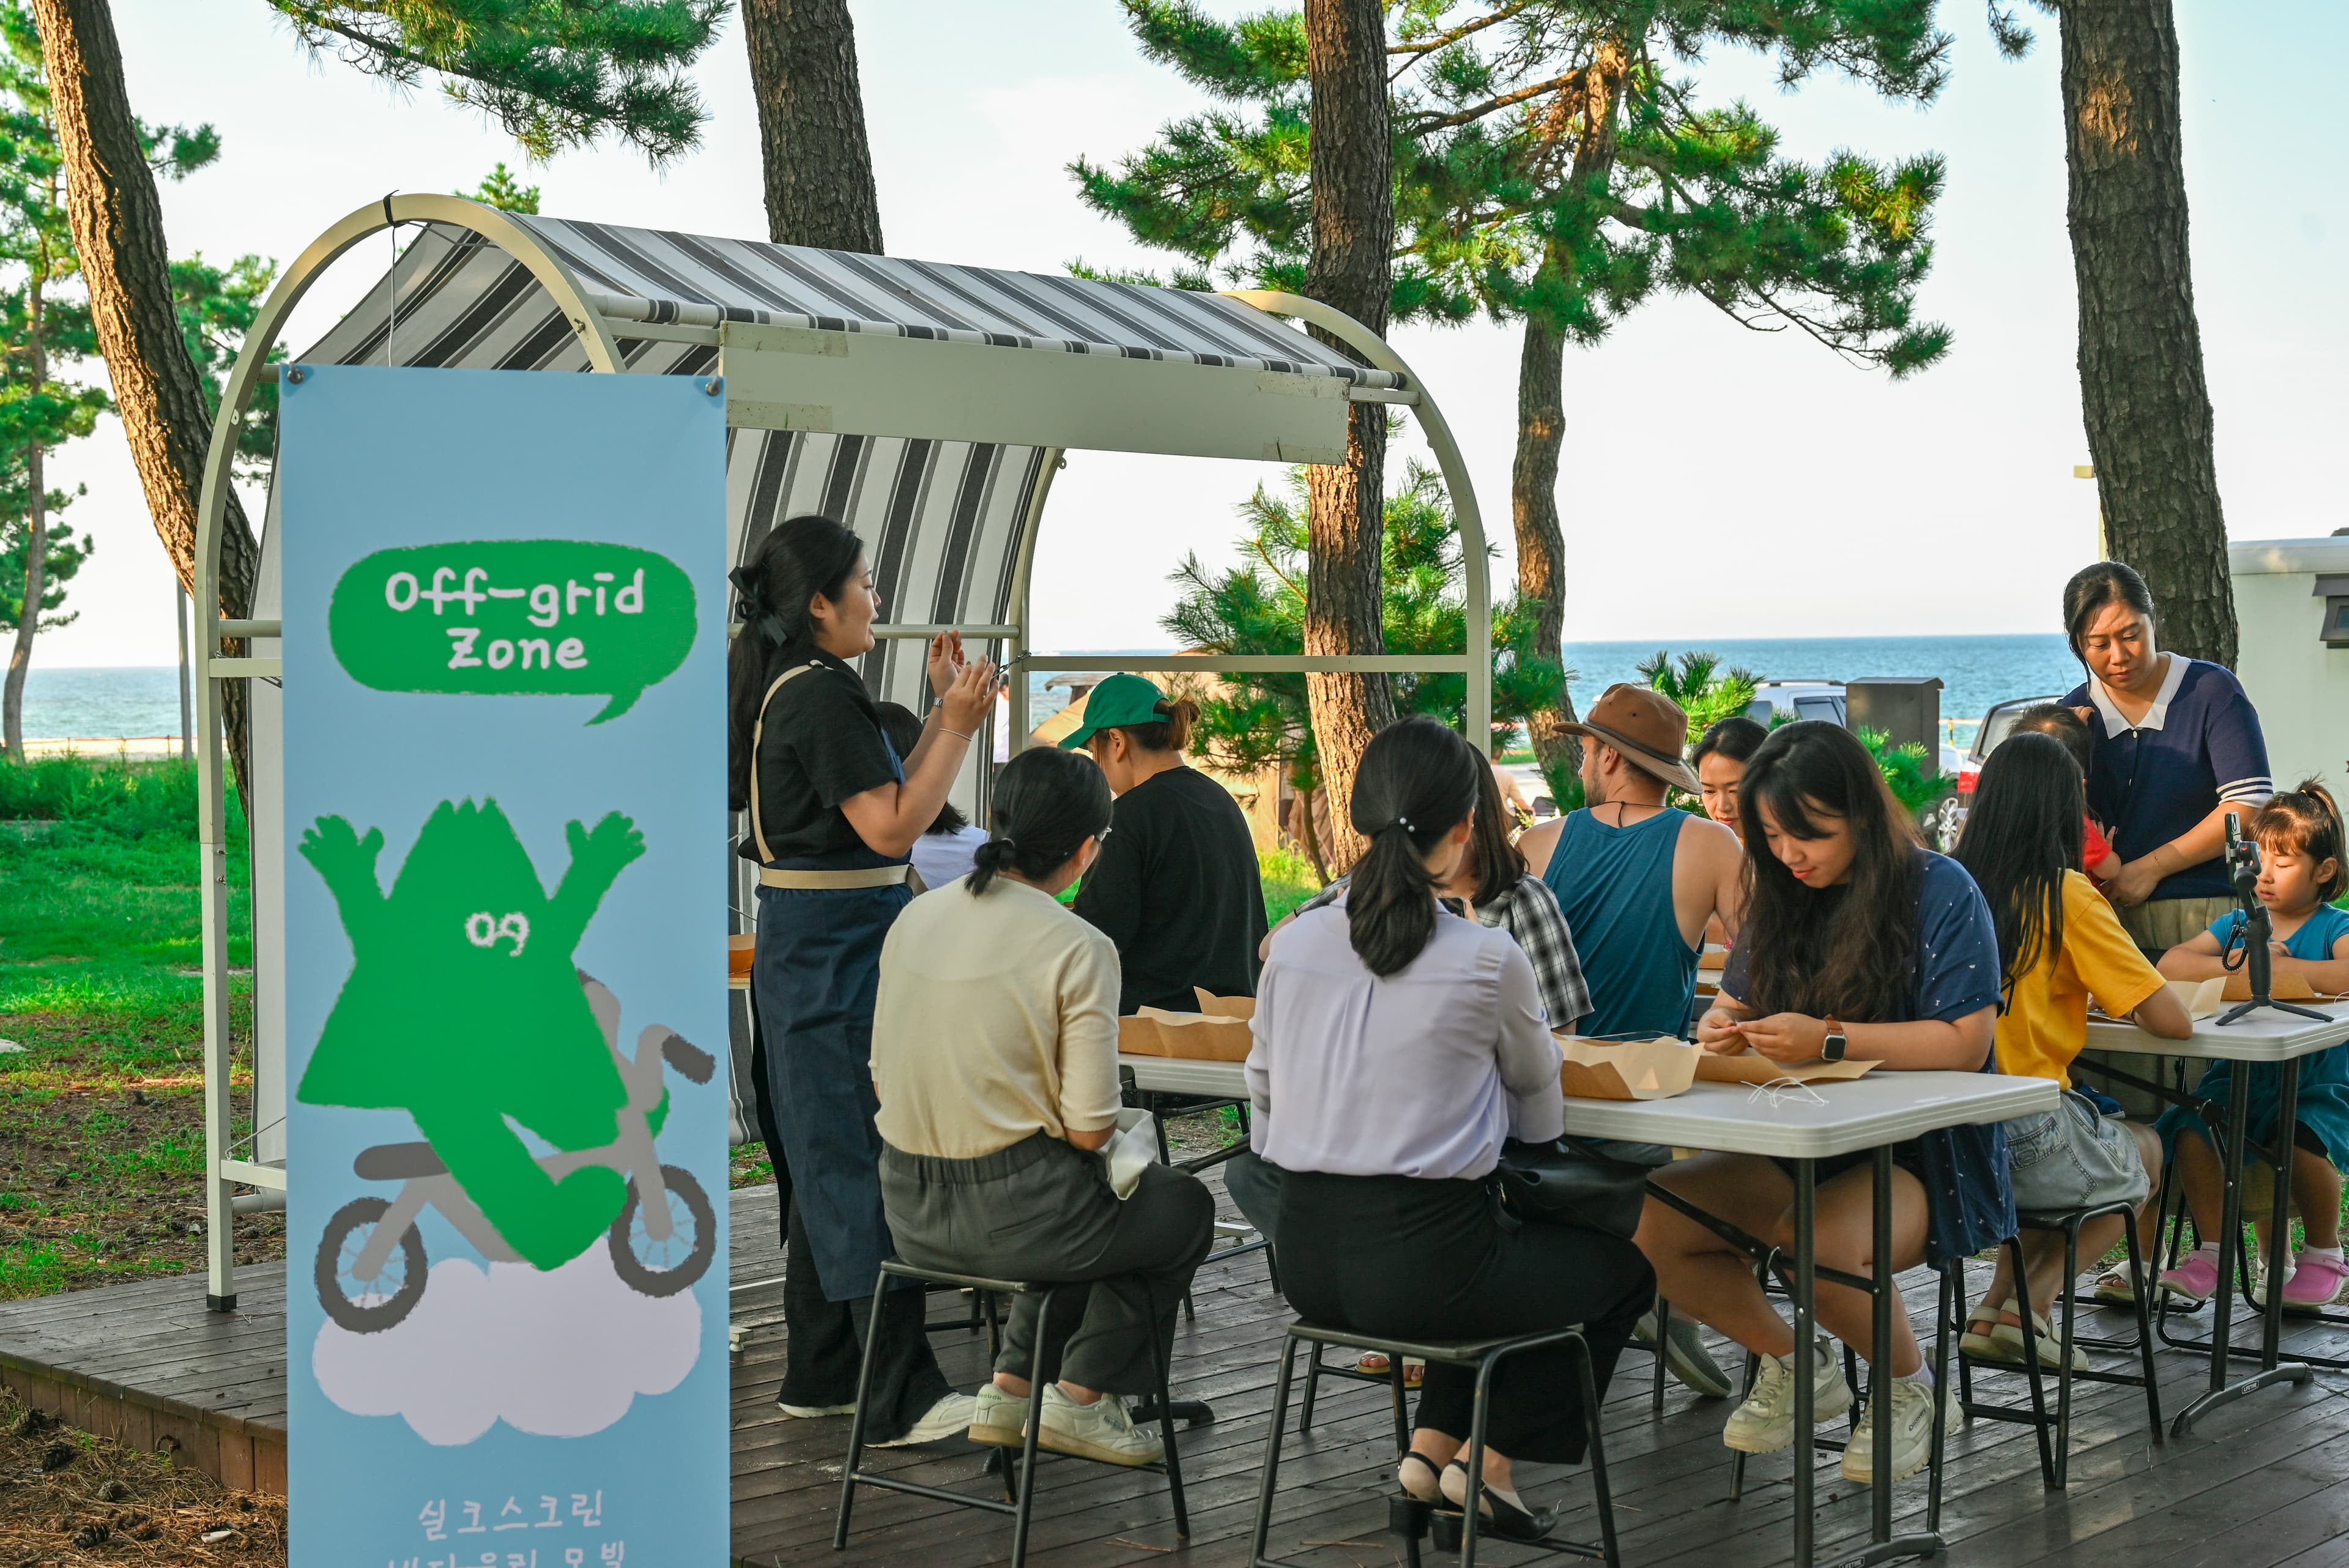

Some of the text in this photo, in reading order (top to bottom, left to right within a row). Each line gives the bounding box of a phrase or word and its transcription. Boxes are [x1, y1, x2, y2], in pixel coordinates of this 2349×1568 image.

[385, 567, 644, 628] Off-grid
[447, 628, 588, 669] Zone
[418, 1490, 602, 1541] 실크스크린
